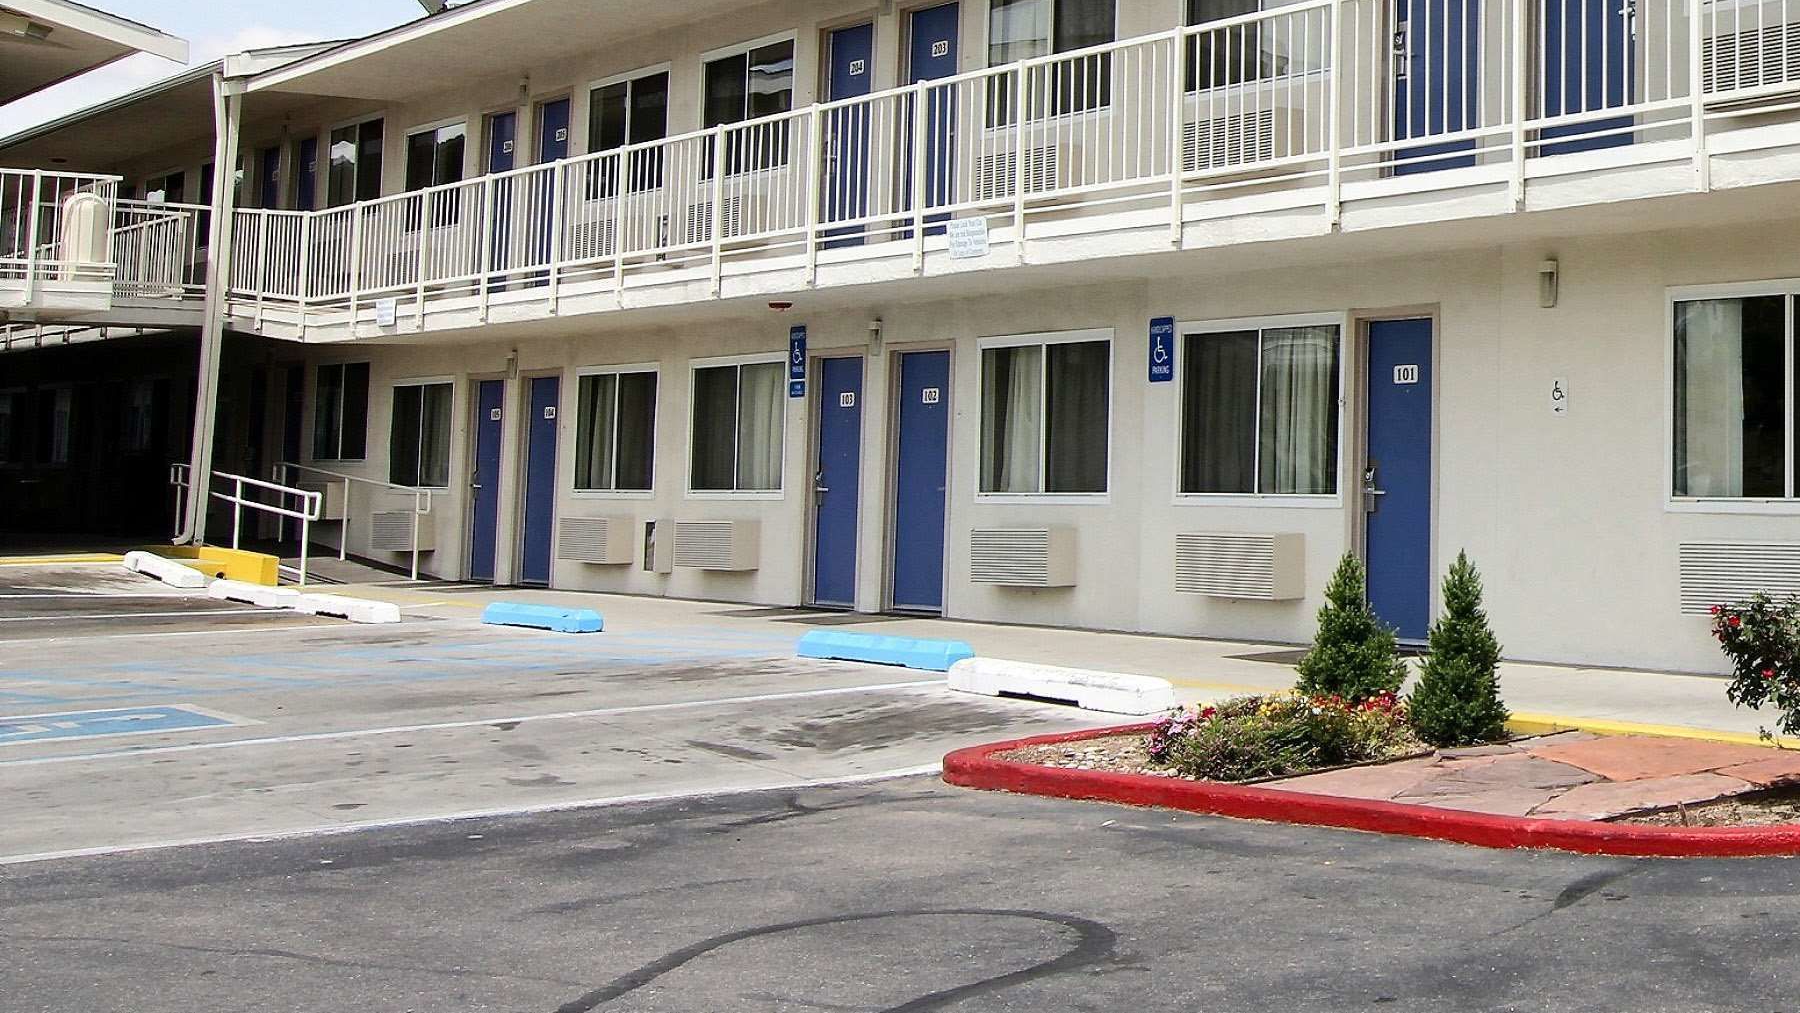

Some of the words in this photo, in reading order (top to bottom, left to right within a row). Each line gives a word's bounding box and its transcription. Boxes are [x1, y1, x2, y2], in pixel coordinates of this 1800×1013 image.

[934, 42, 946, 55] 203
[1397, 367, 1414, 381] 101
[842, 393, 853, 405] 103
[924, 389, 937, 402] 102
